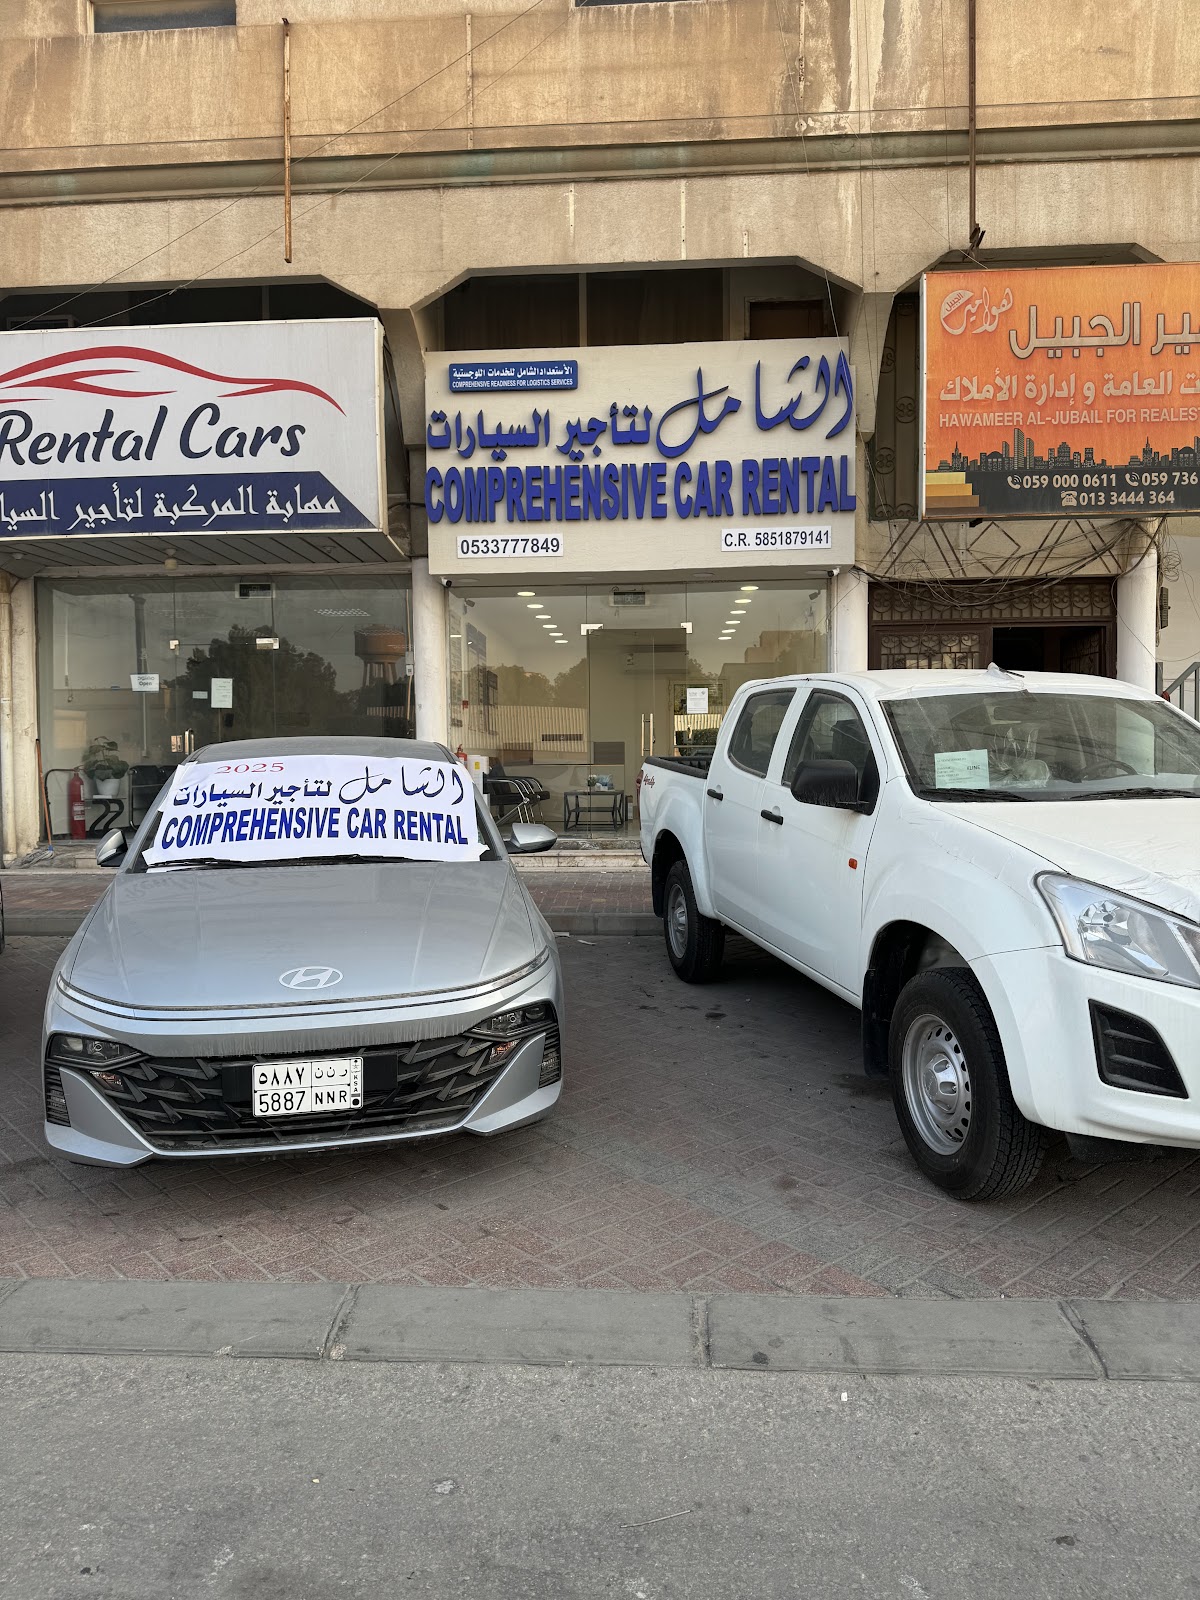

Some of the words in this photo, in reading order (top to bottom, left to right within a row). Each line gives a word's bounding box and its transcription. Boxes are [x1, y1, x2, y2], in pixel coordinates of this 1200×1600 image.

[1008, 301, 1141, 360] الجبيل
[452, 380, 491, 389] COMPREHENSIVE
[491, 379, 517, 388] READINESS
[517, 379, 526, 387] FOR
[527, 378, 550, 387] LOGISTICS
[551, 378, 573, 386] SERVICES
[939, 367, 1018, 402] الأملاك
[1024, 372, 1076, 406] إدارة
[1083, 381, 1096, 405] و
[1103, 369, 1173, 397] العامة
[656, 350, 853, 459] الشامل
[939, 411, 1023, 428] HAWAMEER
[1026, 409, 1103, 425] AL-JUBAIL
[1106, 408, 1137, 423] FOR
[1140, 406, 1200, 422] REALES
[0, 405, 168, 466] Rental
[179, 402, 306, 459] Cars
[427, 408, 550, 461] السيارات
[556, 402, 654, 462] لتأجير
[425, 462, 669, 524] COMPREHENSIVE
[673, 460, 734, 519] CAR
[742, 455, 856, 515] RENTAL
[1022, 474, 1049, 489] 059
[1052, 474, 1079, 488] 000
[1082, 473, 1117, 487] 0611
[1141, 472, 1168, 486] 059
[1172, 471, 1199, 485] 736
[67, 481, 144, 531] لتأجير
[153, 484, 259, 527] المركبة
[265, 484, 341, 523] مهابة
[1079, 491, 1106, 506] 013
[1109, 491, 1145, 505] 3444
[1148, 490, 1175, 504] 364
[460, 537, 560, 555] 0533777849
[724, 532, 751, 547] C.R.
[755, 530, 830, 547] 5851879141
[214, 762, 284, 774] 2025
[173, 780, 263, 808] السيارات
[264, 778, 333, 806] لتأجير
[339, 765, 465, 806] الشامل
[161, 807, 342, 849] COMPREHENSIVE
[346, 808, 388, 839] CAR
[393, 810, 469, 845] RENTAL
[259, 1067, 305, 1087] ٥٨٨٧
[259, 1090, 306, 1113] 5887
